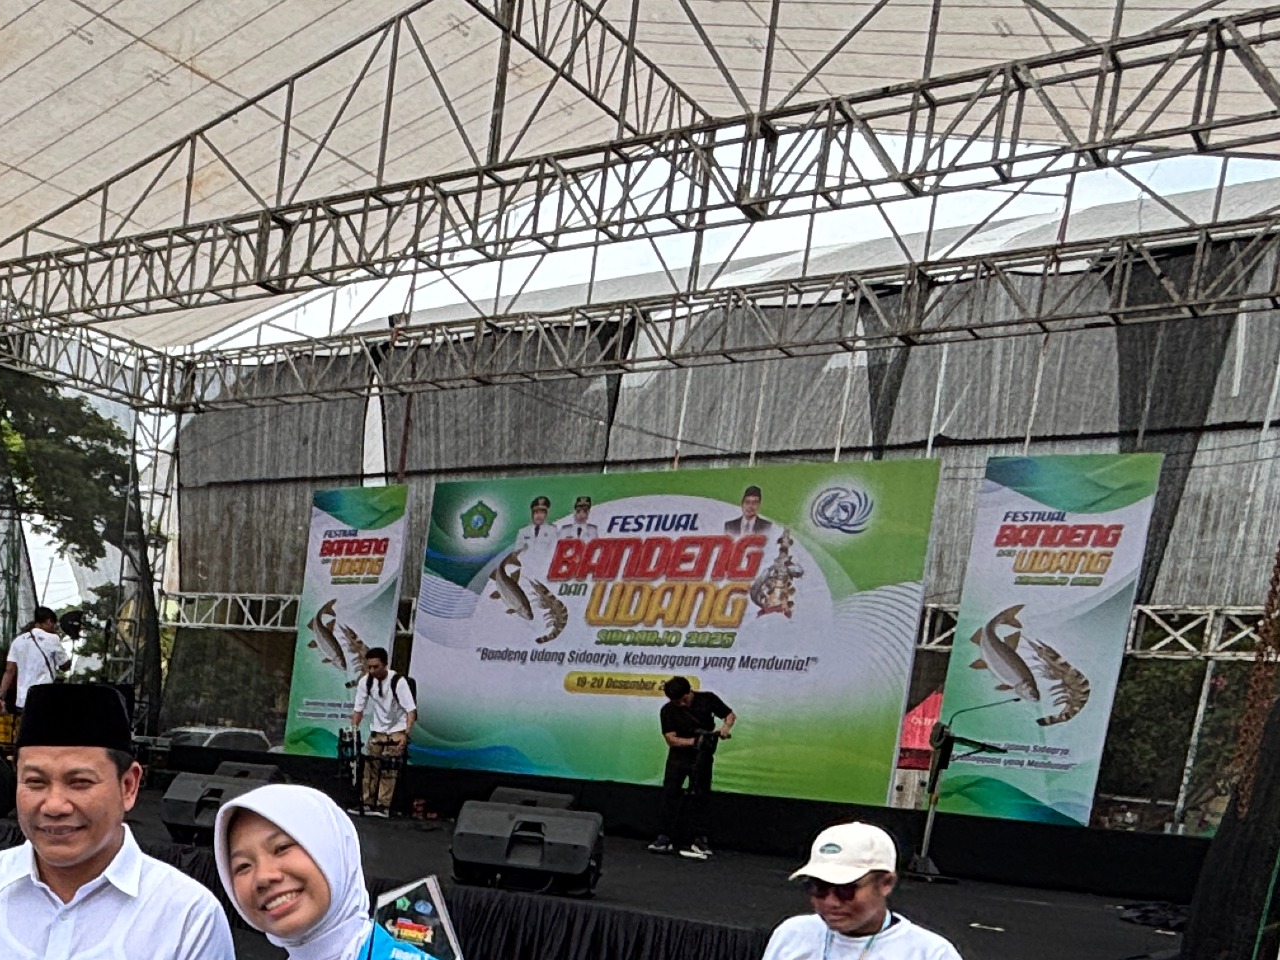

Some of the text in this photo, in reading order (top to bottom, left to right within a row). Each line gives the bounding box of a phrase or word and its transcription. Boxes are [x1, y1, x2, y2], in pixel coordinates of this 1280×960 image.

[607, 513, 699, 533] FESTIVAL
[1003, 510, 1067, 522] FESTIVAL
[994, 524, 1125, 548] BANDENG
[319, 538, 389, 557] BANDENG
[547, 534, 767, 582] BANDENG
[1013, 550, 1113, 575] UDANG
[558, 583, 588, 597] DAN
[584, 580, 752, 629] UDANG
[682, 631, 738, 649] 2025
[530, 648, 566, 666] Udang
[623, 651, 700, 669] Kebanggaan
[701, 656, 735, 671] yang
